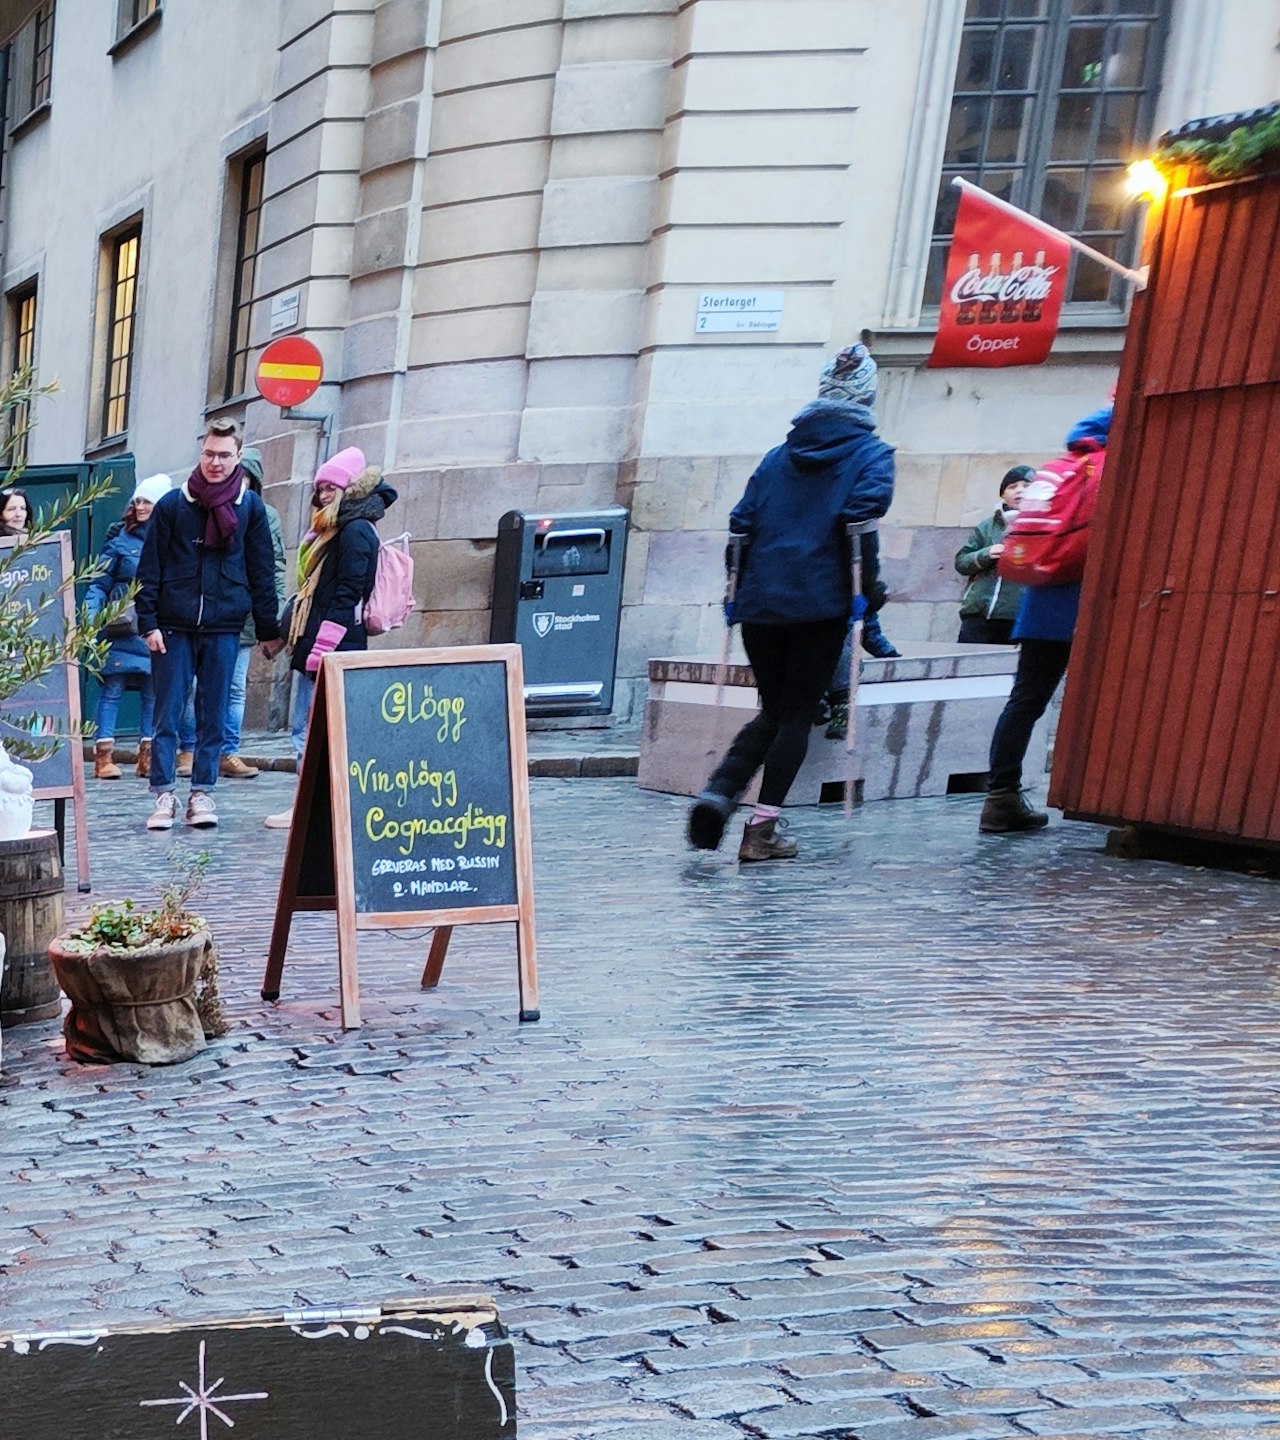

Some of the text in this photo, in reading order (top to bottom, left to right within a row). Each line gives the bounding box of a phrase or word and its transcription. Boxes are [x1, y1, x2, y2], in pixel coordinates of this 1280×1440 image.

[950, 264, 1061, 304] Coca-Cola
[703, 296, 756, 309] Stortorget
[700, 317, 707, 328] 2
[966, 334, 1021, 352] Öppet
[555, 614, 600, 623] Stockholms
[381, 682, 467, 743] Glögg
[350, 758, 458, 808] Vinglögg
[366, 802, 507, 855] Cognacglögg
[456, 855, 500, 870] RUSSIN
